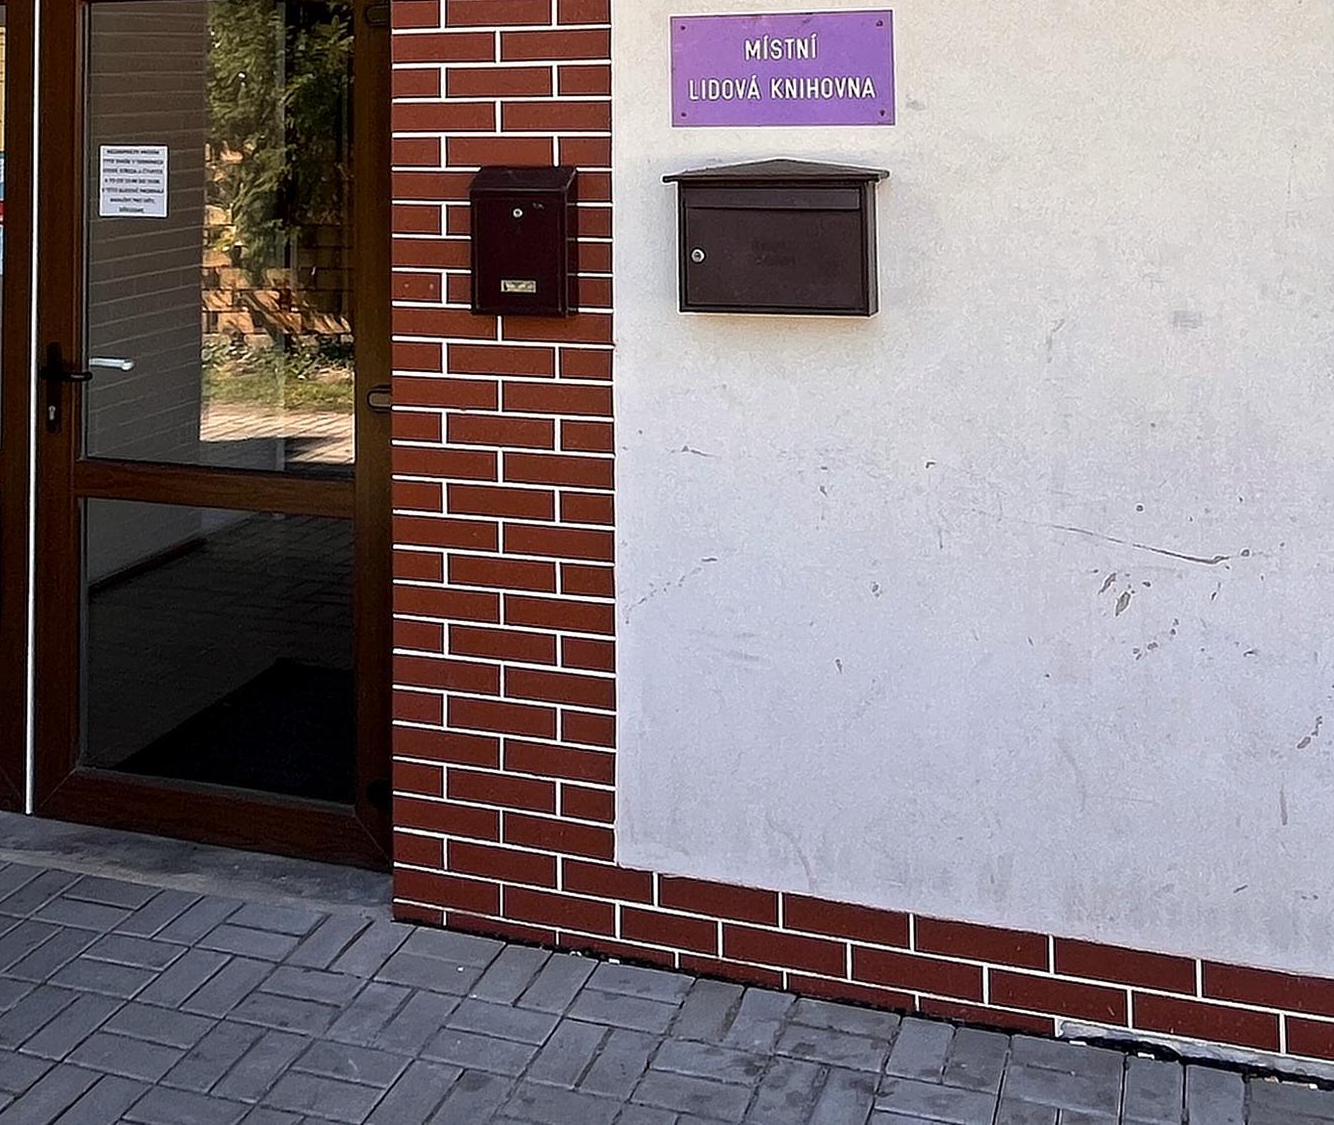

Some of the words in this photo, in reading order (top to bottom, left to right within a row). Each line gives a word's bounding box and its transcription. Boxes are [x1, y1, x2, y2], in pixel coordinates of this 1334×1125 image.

[744, 33, 818, 61] MÍSTNÍ
[688, 74, 762, 101] LIDOVÁ
[770, 76, 876, 100] KNIHOVNA
